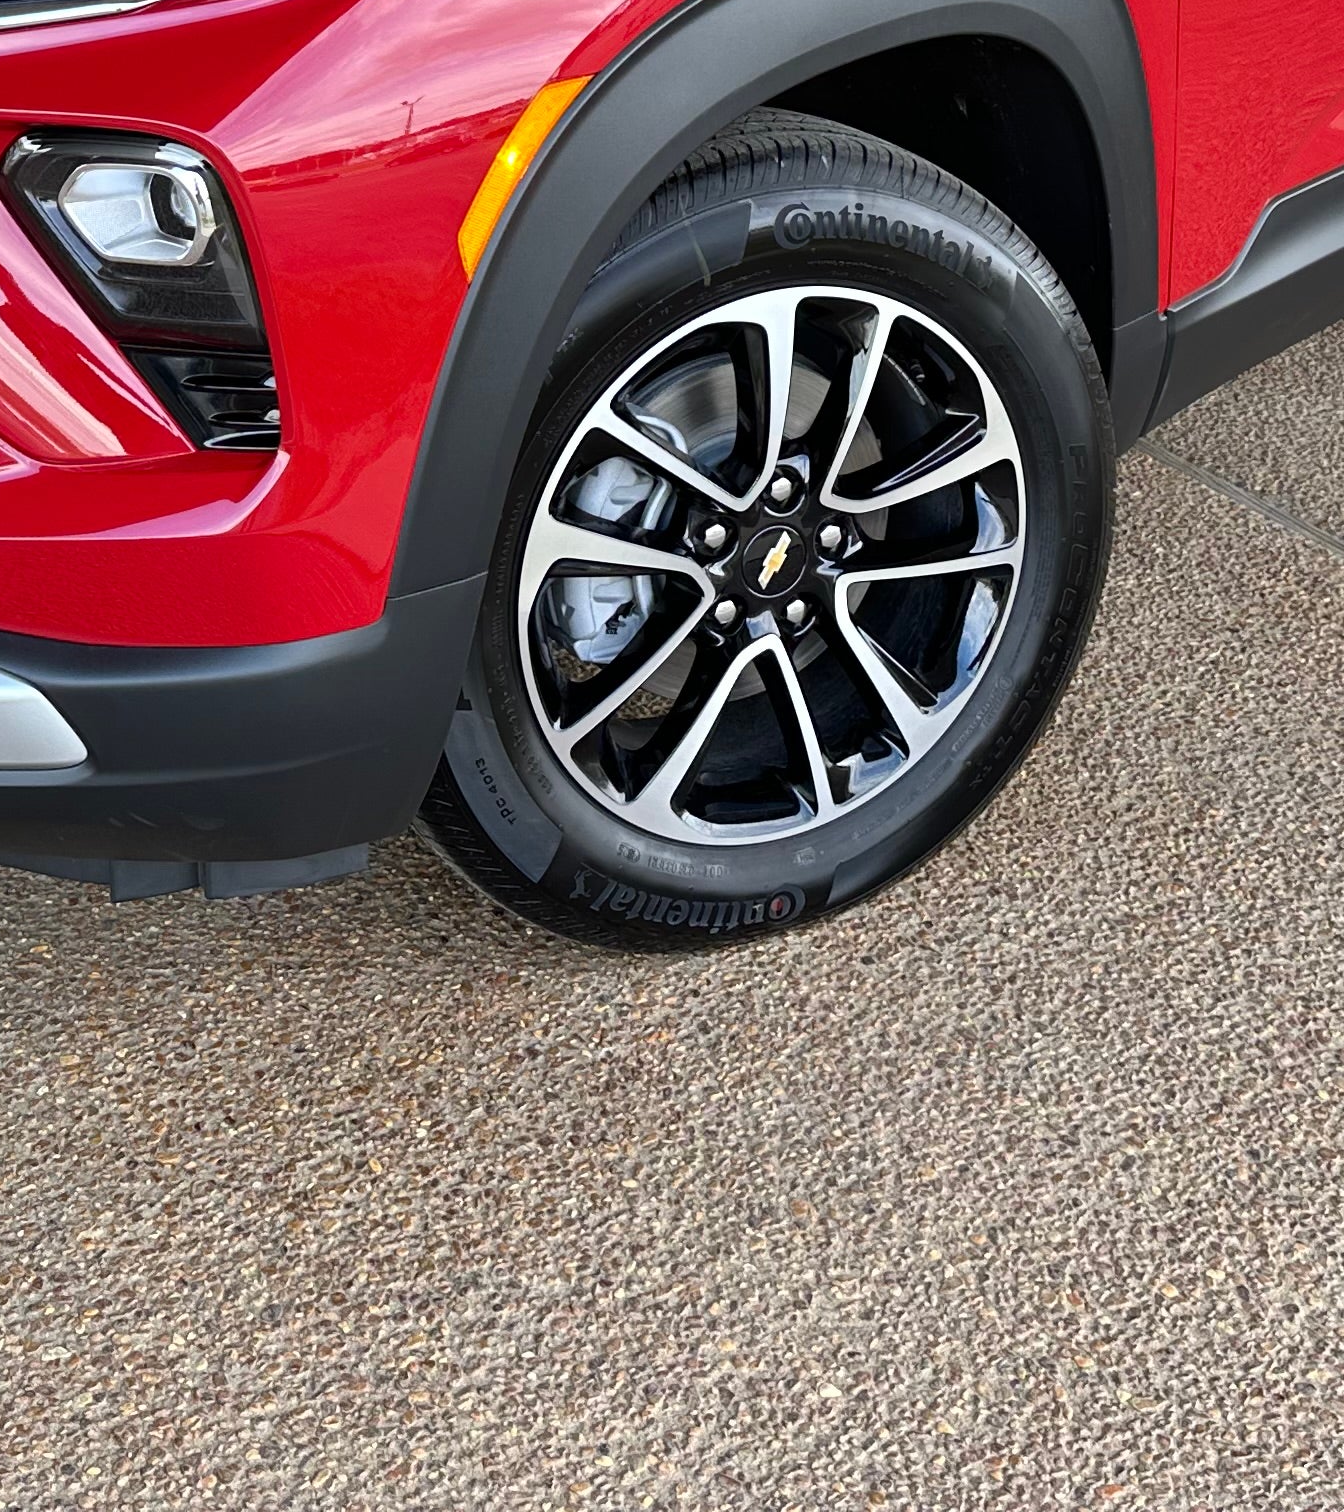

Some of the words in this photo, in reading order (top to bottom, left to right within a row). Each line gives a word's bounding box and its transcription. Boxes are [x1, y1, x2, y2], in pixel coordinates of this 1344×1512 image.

[774, 202, 974, 275] Continental
[475, 757, 498, 794] 4013
[496, 797, 517, 826] TPC
[589, 877, 806, 935] Continental
